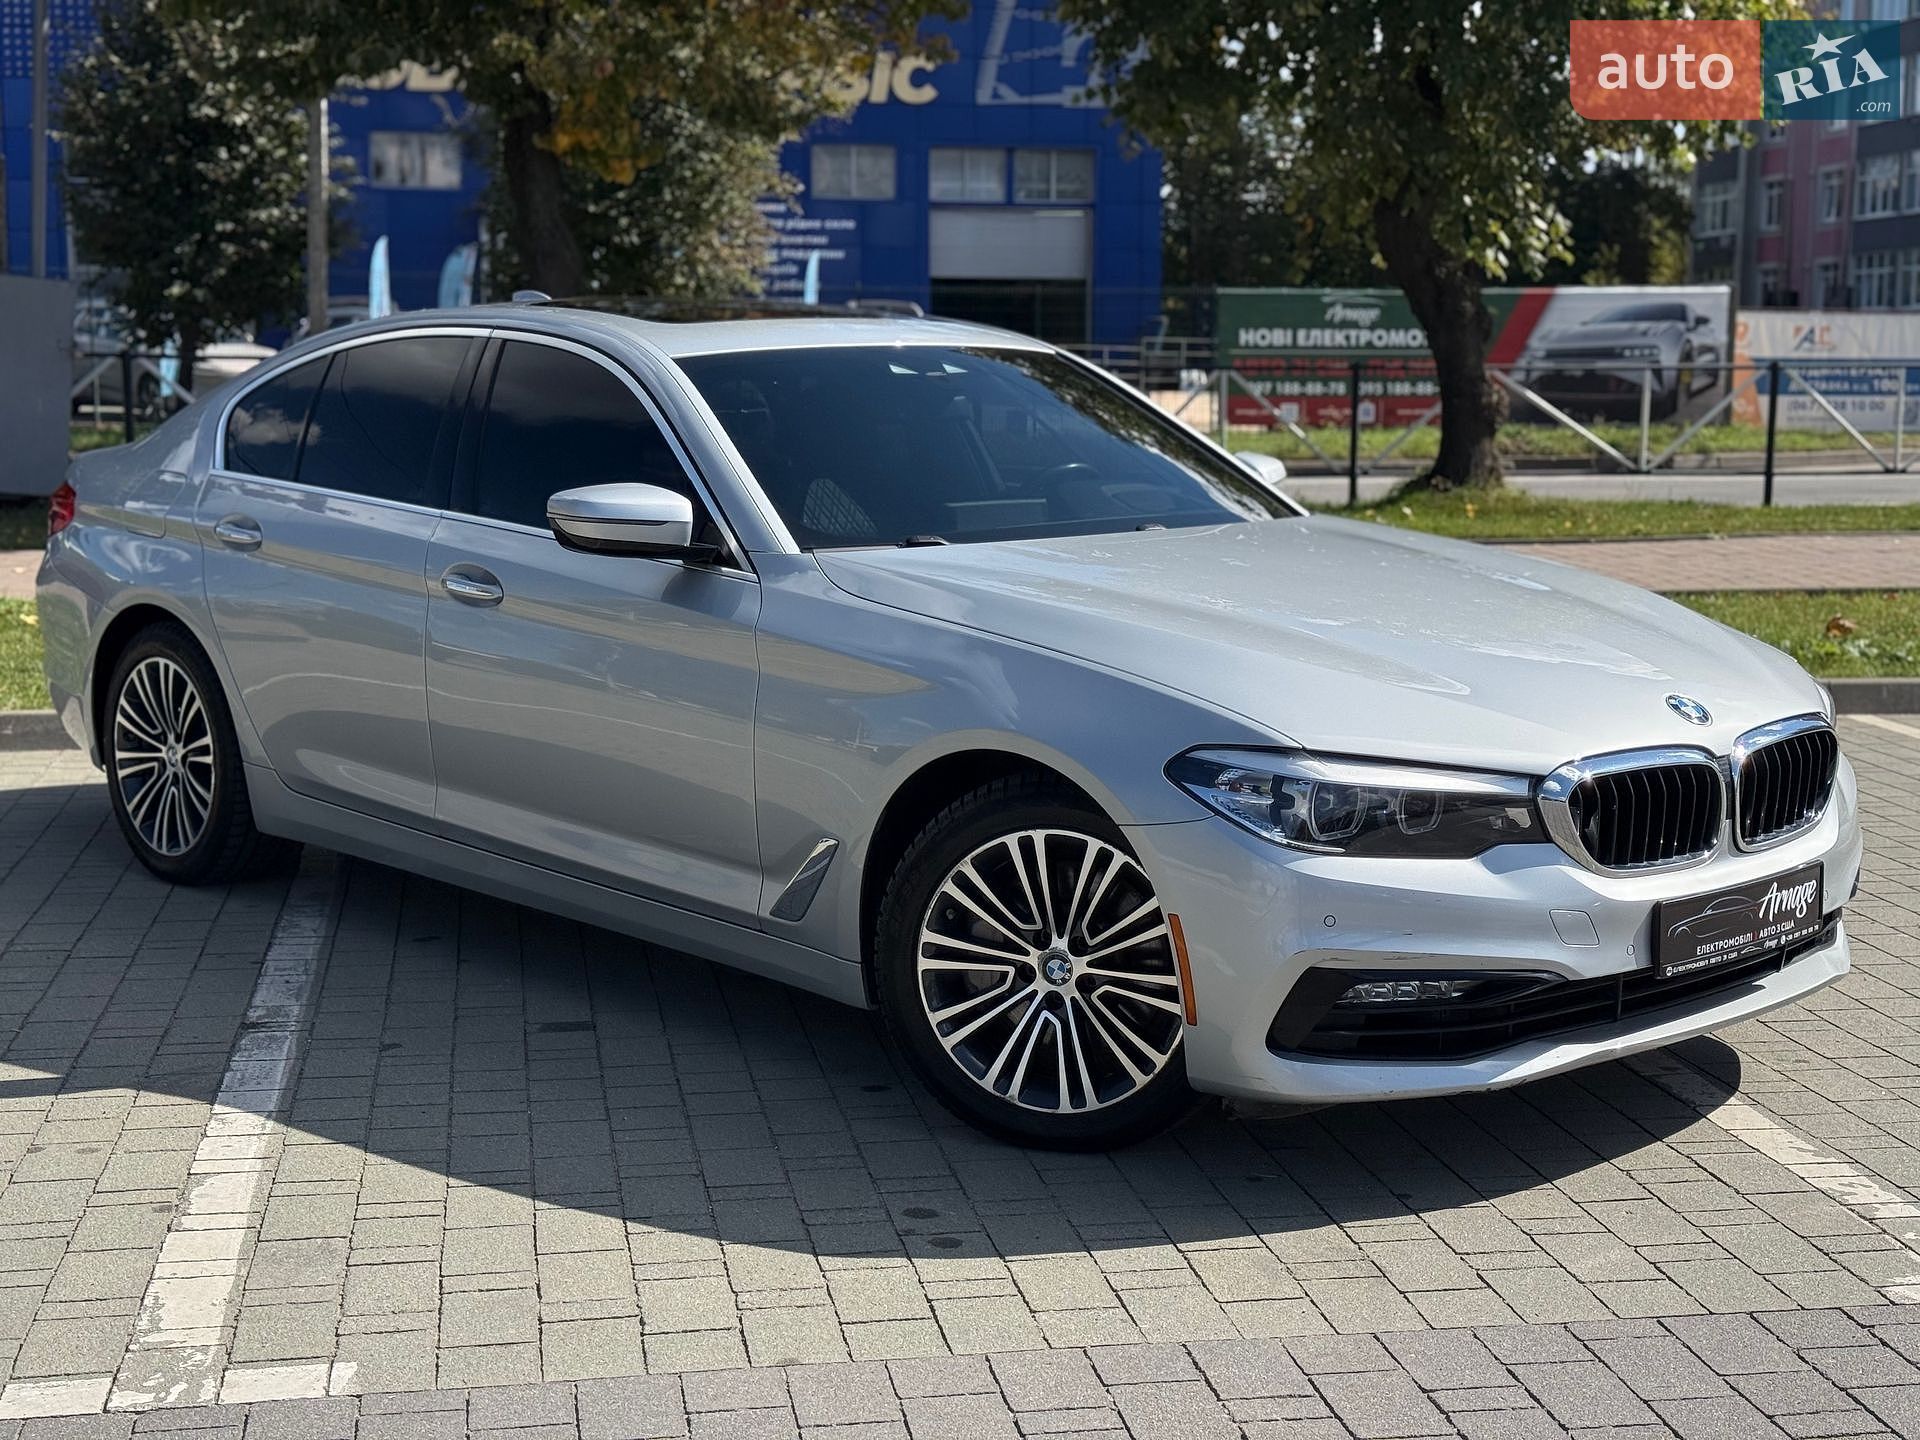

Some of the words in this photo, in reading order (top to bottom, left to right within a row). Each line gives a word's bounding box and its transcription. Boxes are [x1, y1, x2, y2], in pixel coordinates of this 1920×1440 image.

[1238, 328, 1292, 348] НОВІ
[1297, 328, 1428, 348] ЕЛЕКТРОМО
[1696, 932, 1753, 955] ЕЛЕКТРОМОБІЛІ
[1759, 925, 1776, 939] АВТО
[1781, 919, 1795, 932] США
